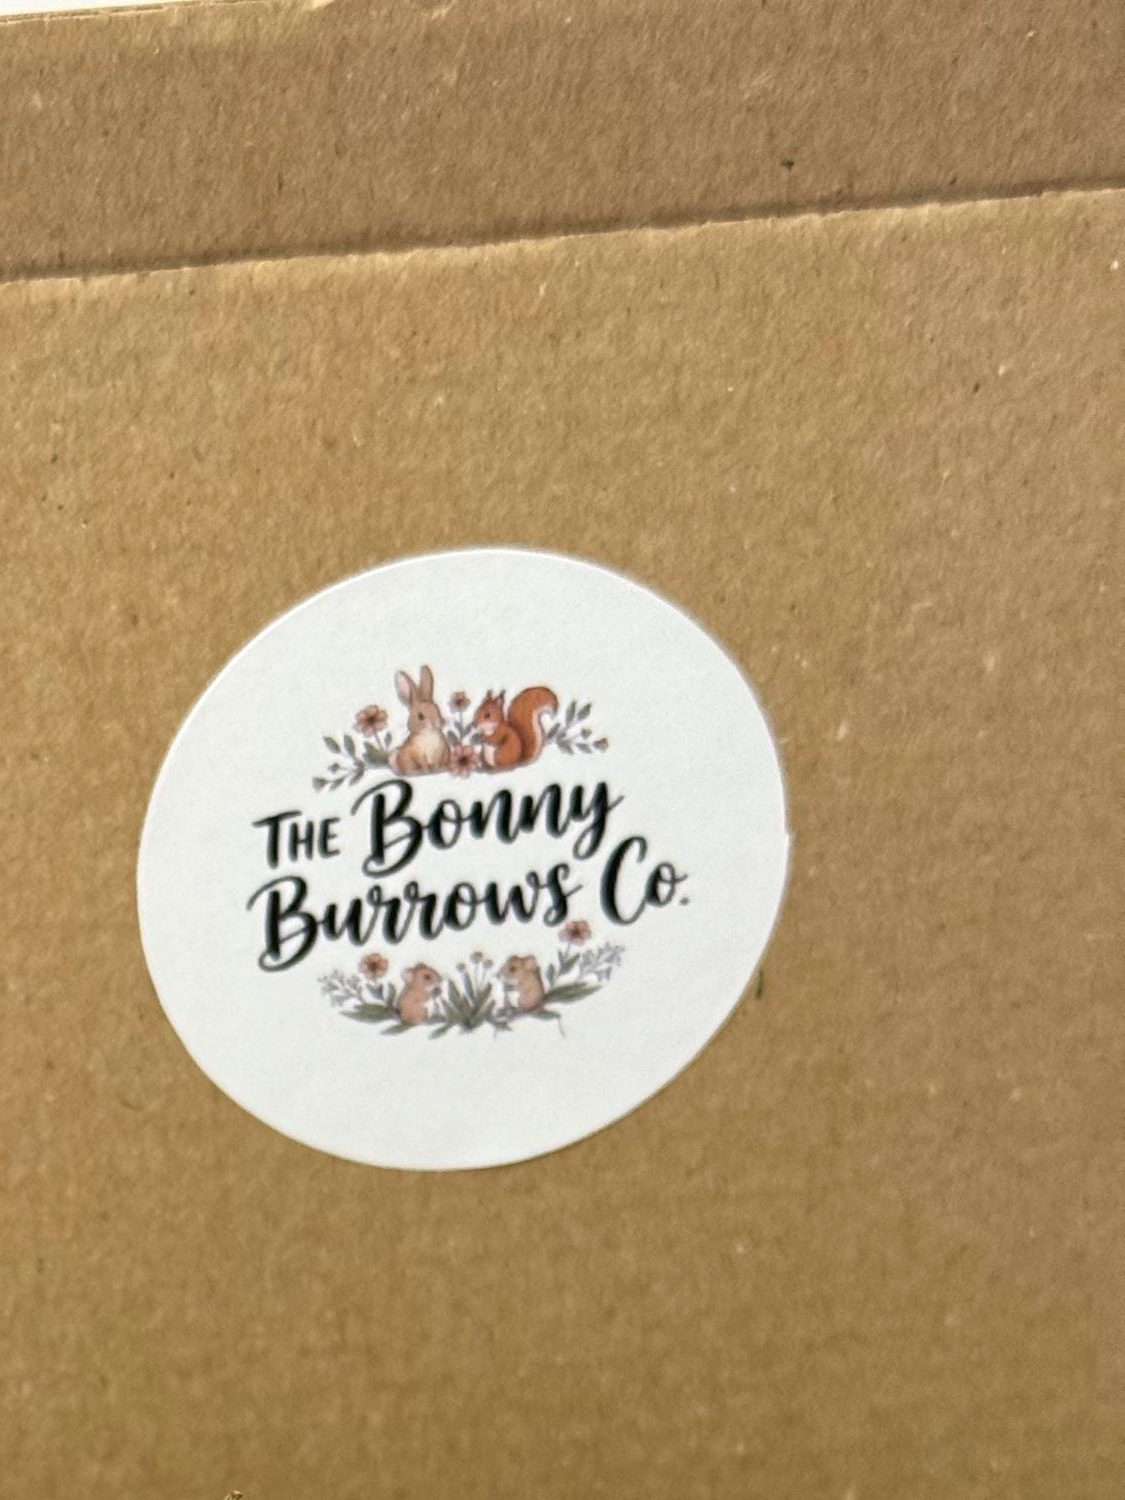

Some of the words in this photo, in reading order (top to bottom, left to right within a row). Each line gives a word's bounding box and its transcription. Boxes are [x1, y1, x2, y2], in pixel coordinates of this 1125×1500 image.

[253, 811, 340, 868] THE
[351, 779, 624, 878] Bonny
[247, 862, 583, 972] Burrows
[600, 836, 690, 924] Co.
